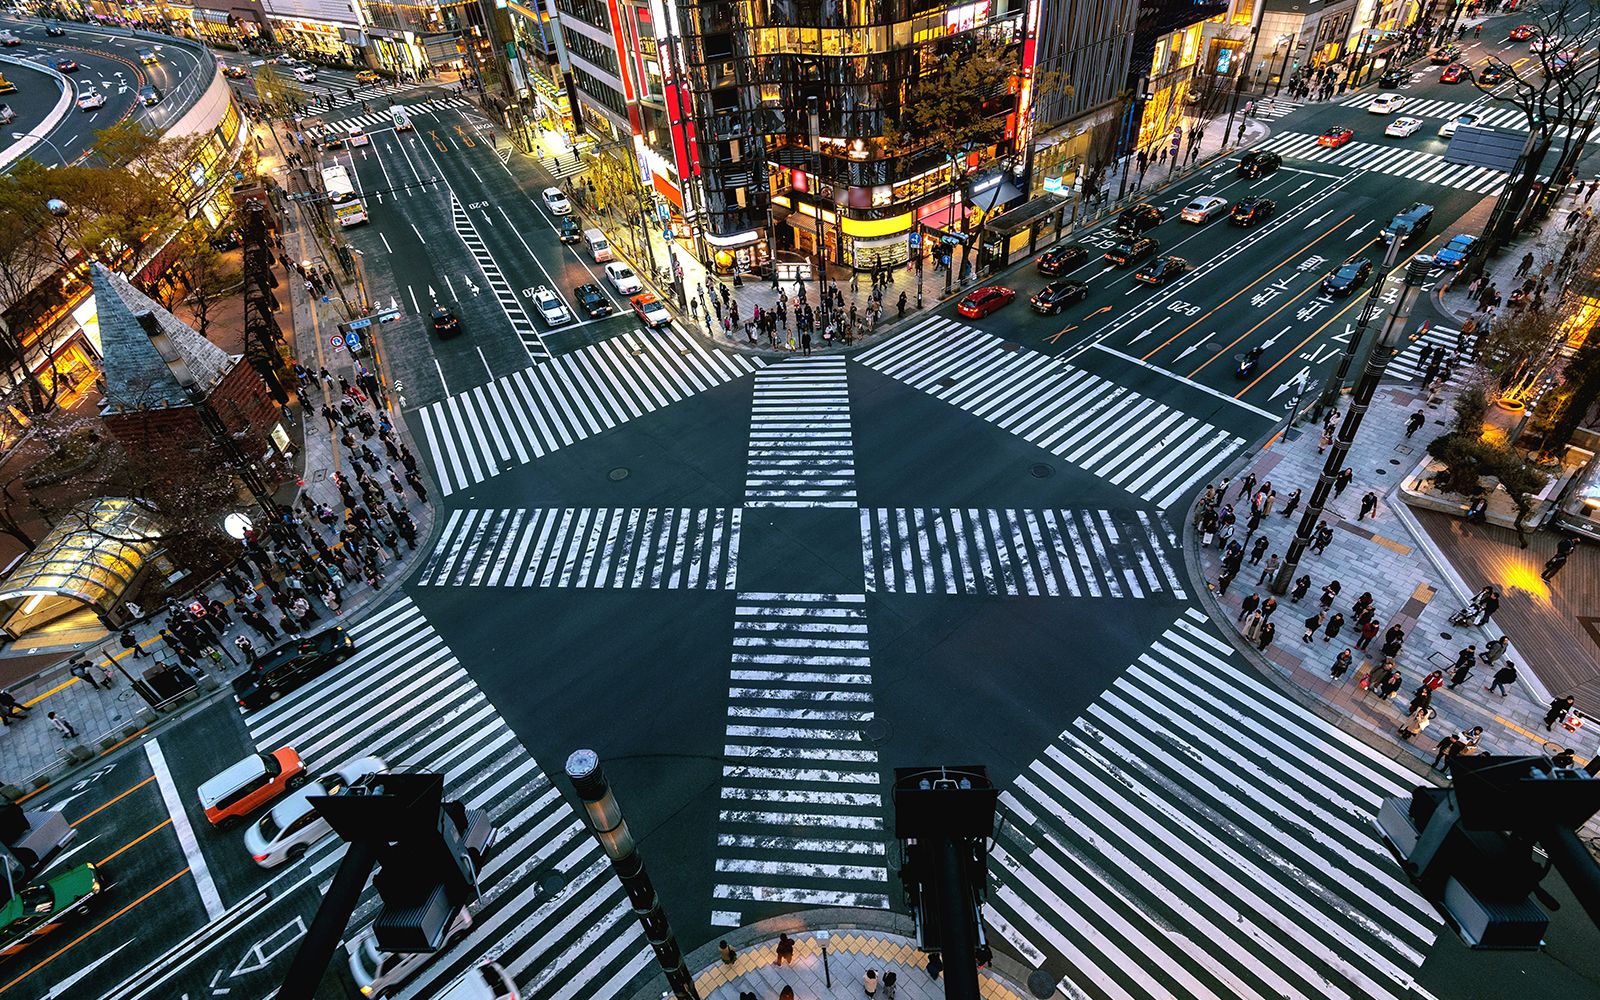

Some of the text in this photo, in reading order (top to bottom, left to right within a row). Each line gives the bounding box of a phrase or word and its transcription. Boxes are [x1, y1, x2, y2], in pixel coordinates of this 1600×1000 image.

[1077, 235, 1117, 250] 17-19
[1250, 254, 1329, 308] 地下道
[1166, 300, 1202, 317] 8-20
